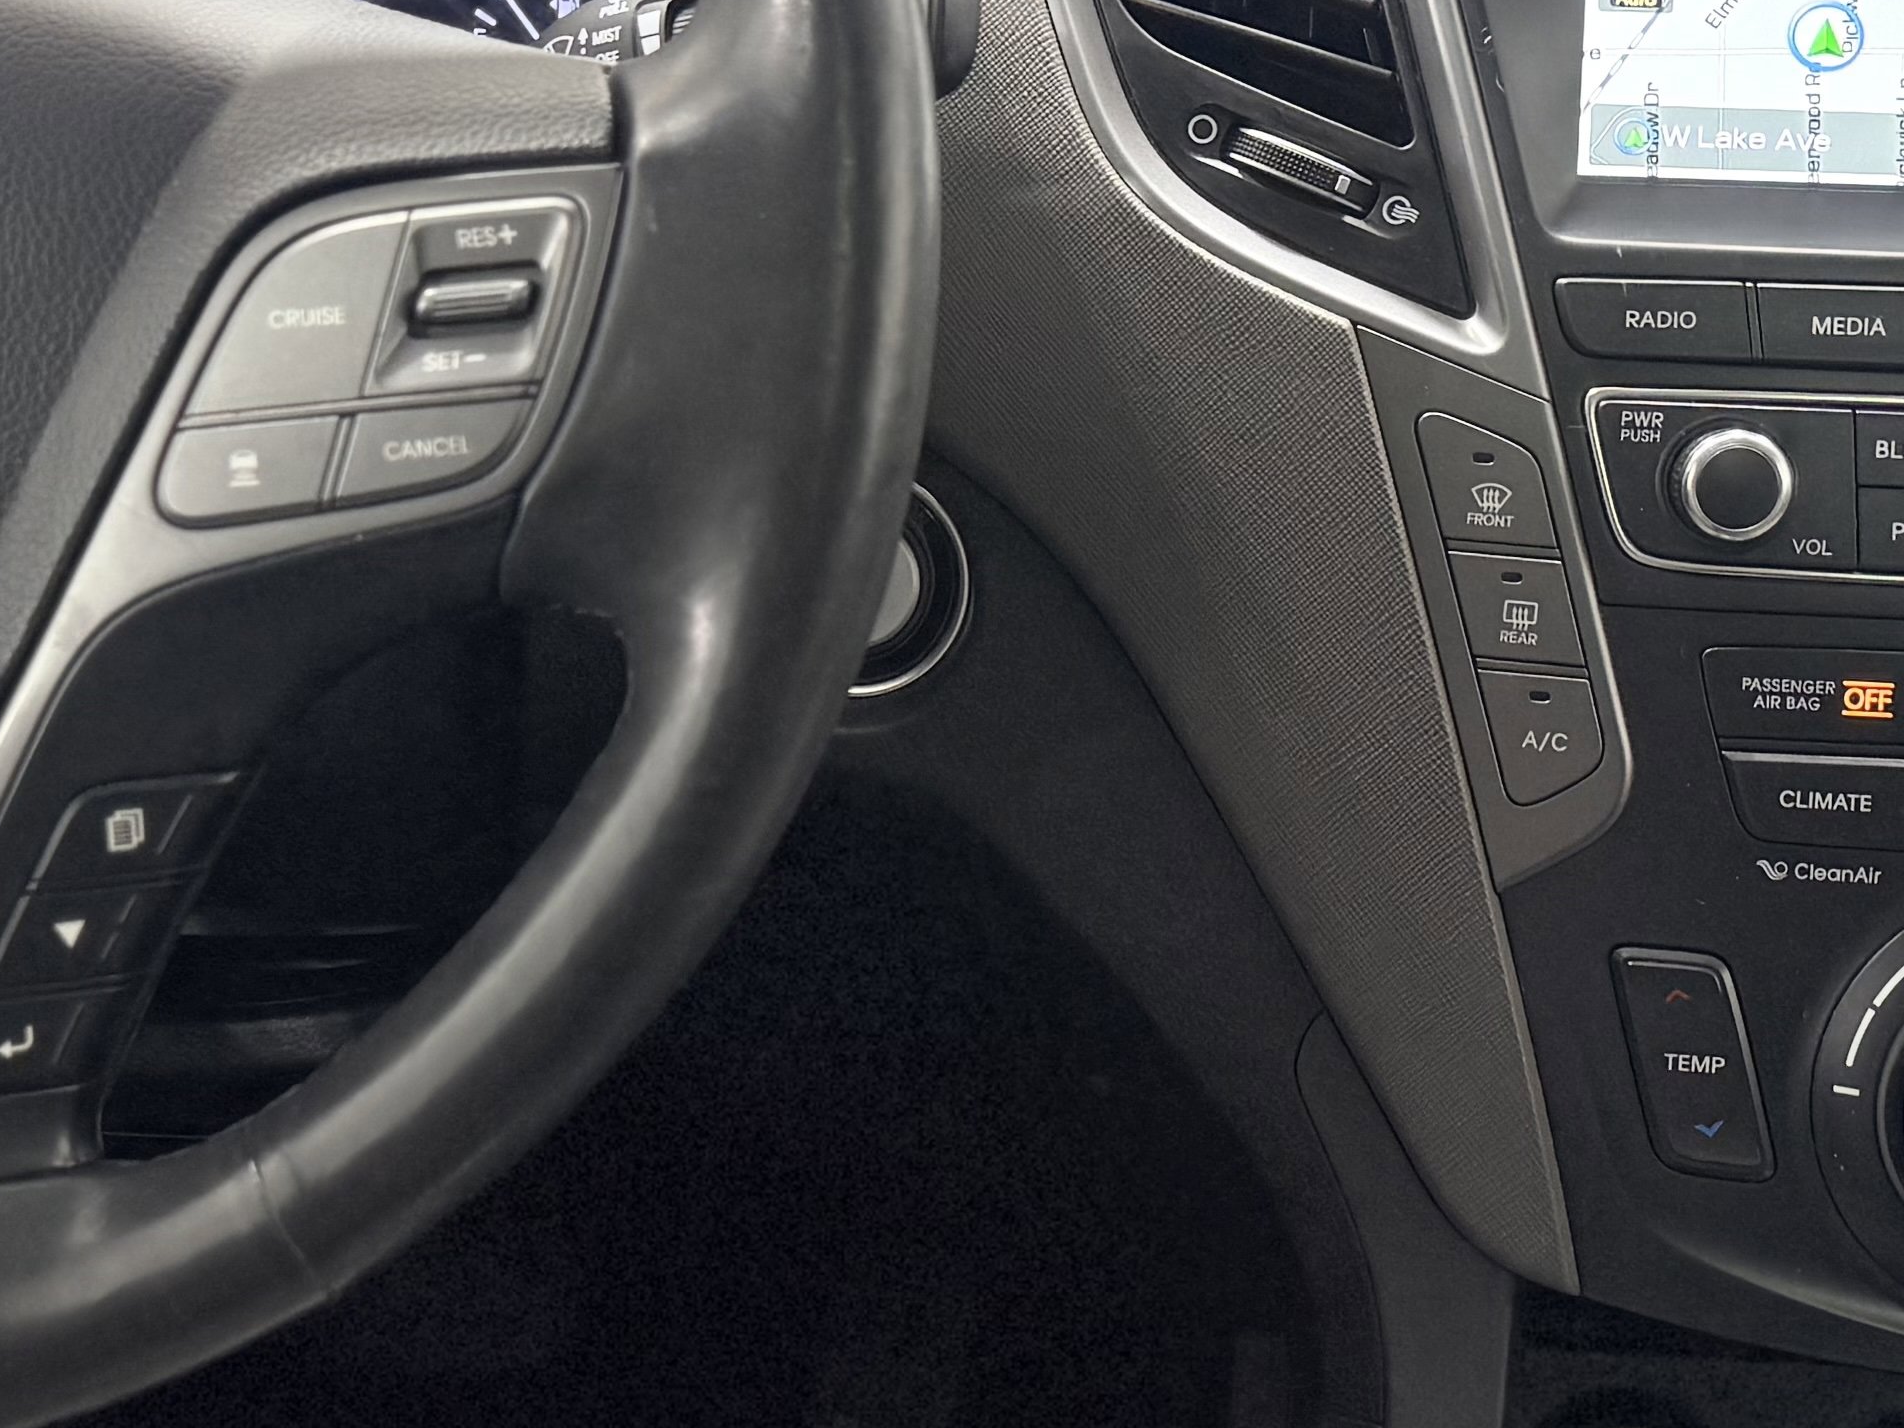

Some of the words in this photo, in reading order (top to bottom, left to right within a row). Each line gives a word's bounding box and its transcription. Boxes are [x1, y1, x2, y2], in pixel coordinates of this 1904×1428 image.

[1644, 82, 1659, 107] Dr
[1663, 124, 1691, 149] W
[1698, 126, 1766, 150] Lake
[1775, 128, 1832, 153] Ave
[268, 306, 346, 329] CRUISE
[1625, 310, 1697, 330] RADIO
[1812, 316, 1886, 338] MEDIA
[1621, 411, 1663, 429] PWR
[1620, 428, 1661, 443] PUSH
[383, 435, 470, 461] CANCEL
[1466, 512, 1514, 528] FRONT
[1792, 538, 1832, 557] VOL
[1500, 631, 1538, 646] REAR
[1742, 677, 1836, 695] PASSENGER
[1753, 695, 1782, 710] AIR
[1786, 696, 1821, 712] BAG
[1843, 688, 1894, 711] OFF
[1521, 731, 1569, 752] A/C
[1779, 790, 1872, 813] CLIMATE
[1794, 863, 1882, 886] CleanAir
[1664, 1053, 1726, 1075] TEMP
